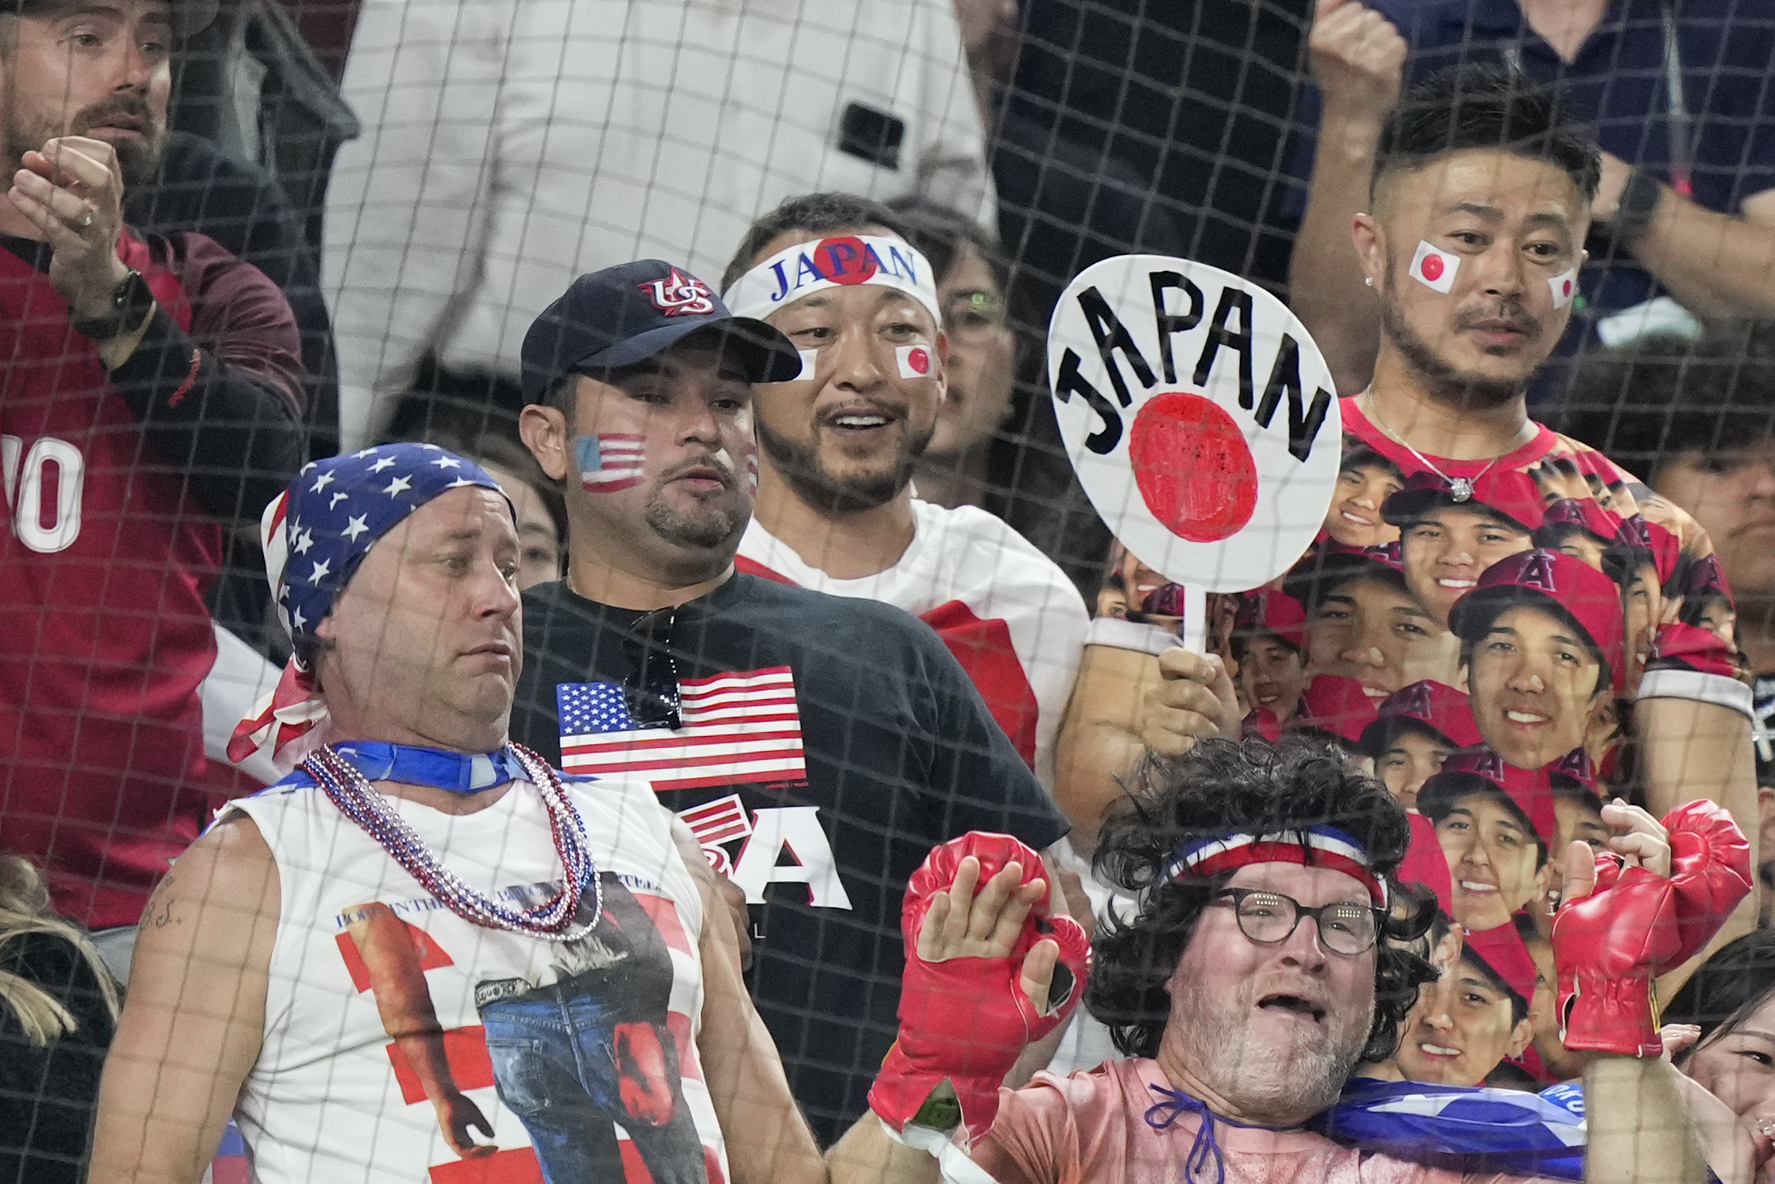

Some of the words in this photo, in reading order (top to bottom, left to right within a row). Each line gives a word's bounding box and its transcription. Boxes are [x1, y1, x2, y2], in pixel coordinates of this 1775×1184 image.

[651, 279, 715, 313] US
[768, 242, 916, 302] JAPAN
[1055, 270, 1332, 463] JAPAN
